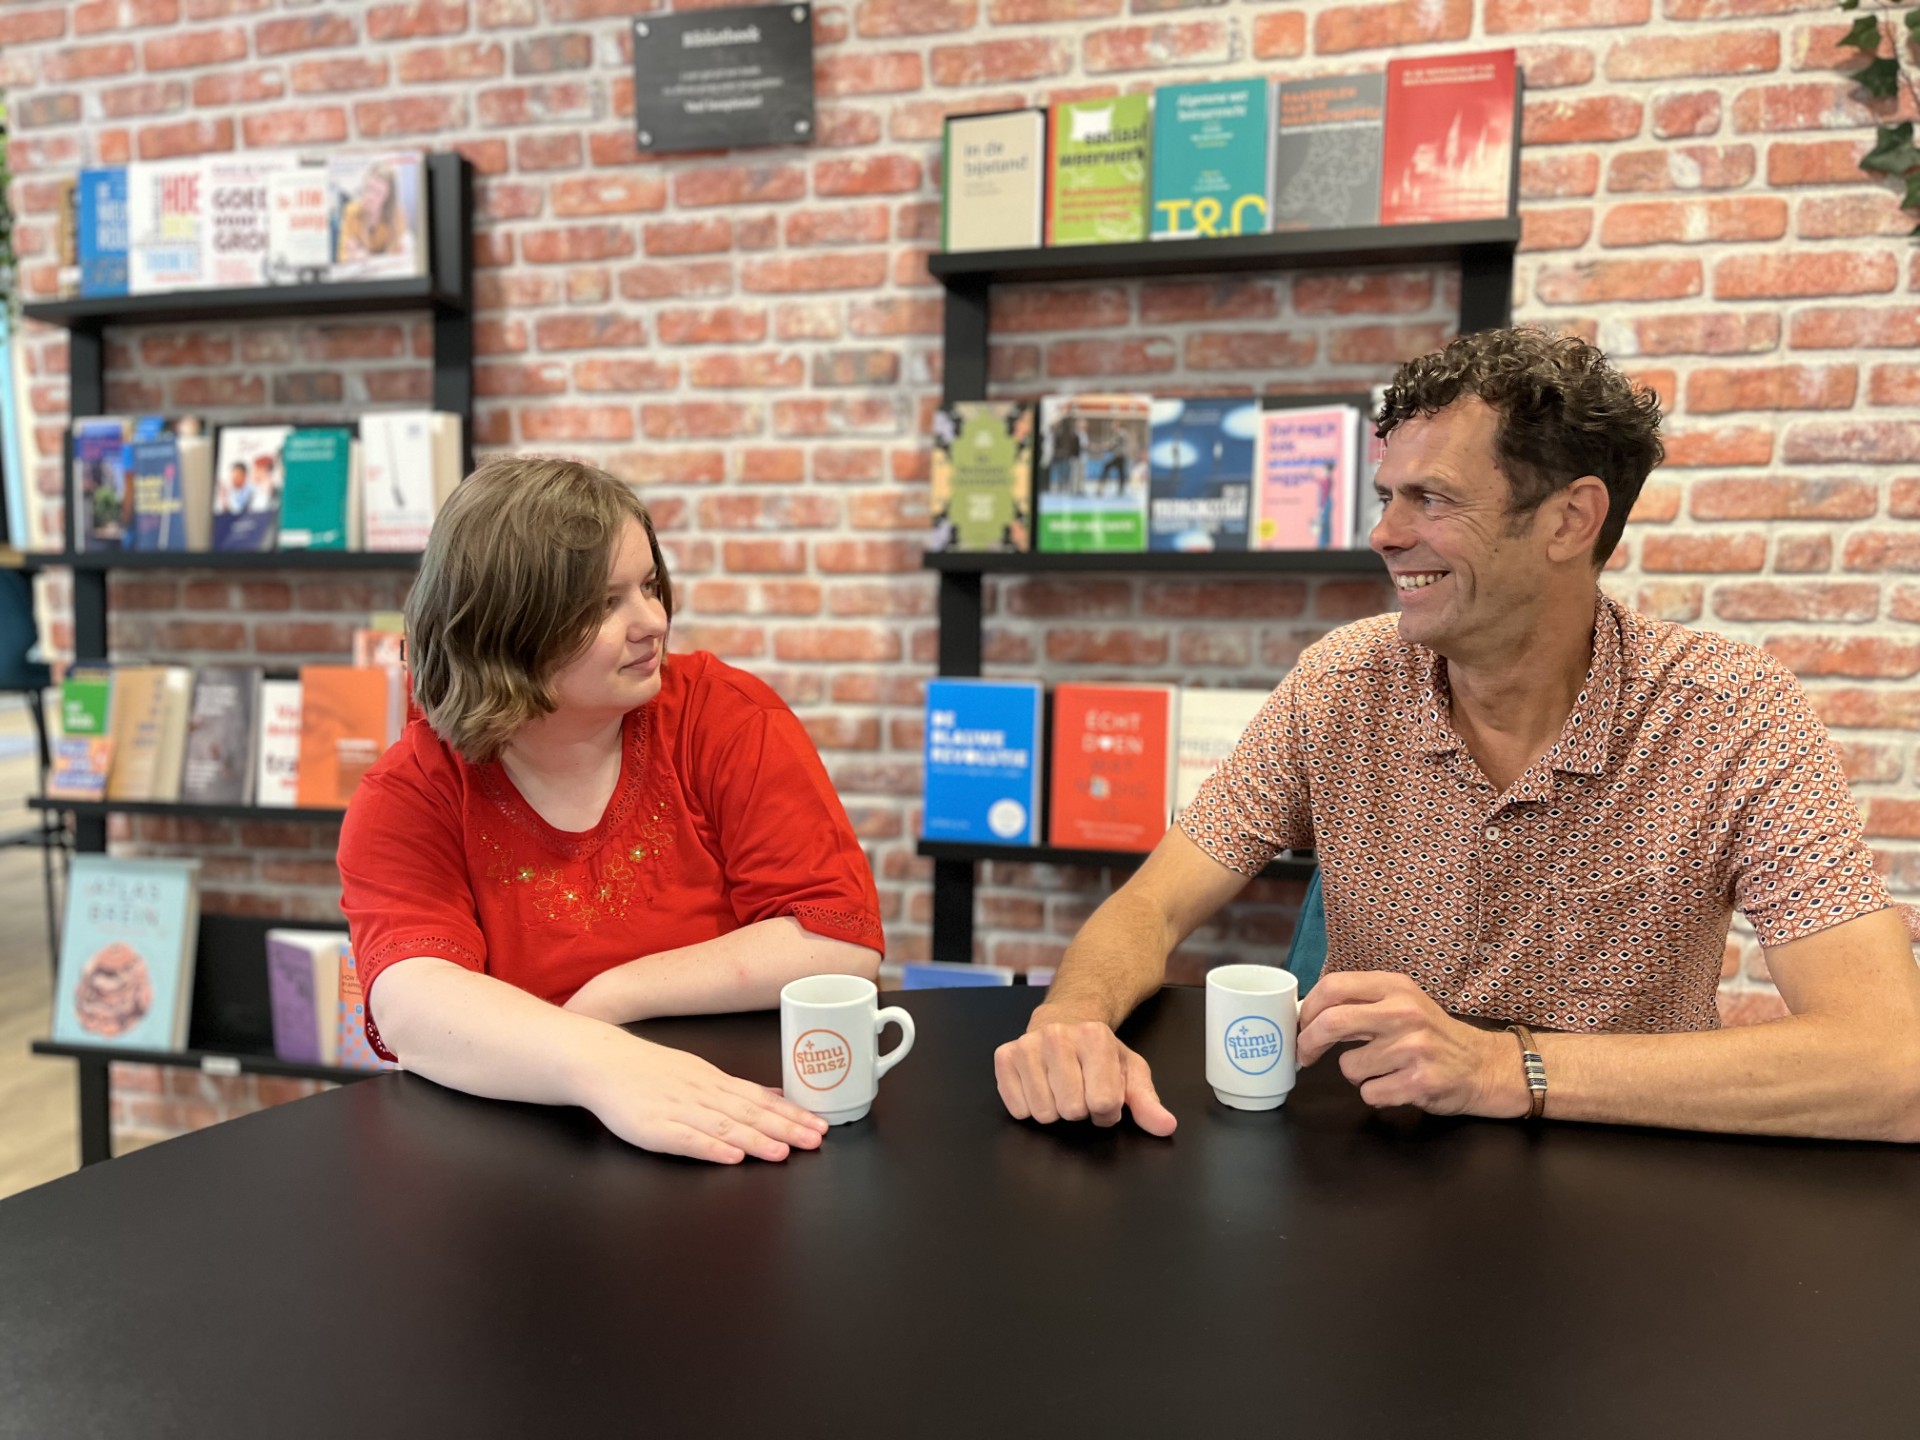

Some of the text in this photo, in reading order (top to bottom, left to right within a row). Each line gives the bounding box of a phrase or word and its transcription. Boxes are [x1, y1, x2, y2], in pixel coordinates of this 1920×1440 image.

[930, 729, 1005, 748] BLAUWE
[930, 749, 1028, 768] REVOLUTIE
[1228, 1028, 1276, 1047] stimu
[796, 1042, 844, 1063] stimu
[1234, 1043, 1278, 1059] lansz
[802, 1057, 847, 1075] lansz
